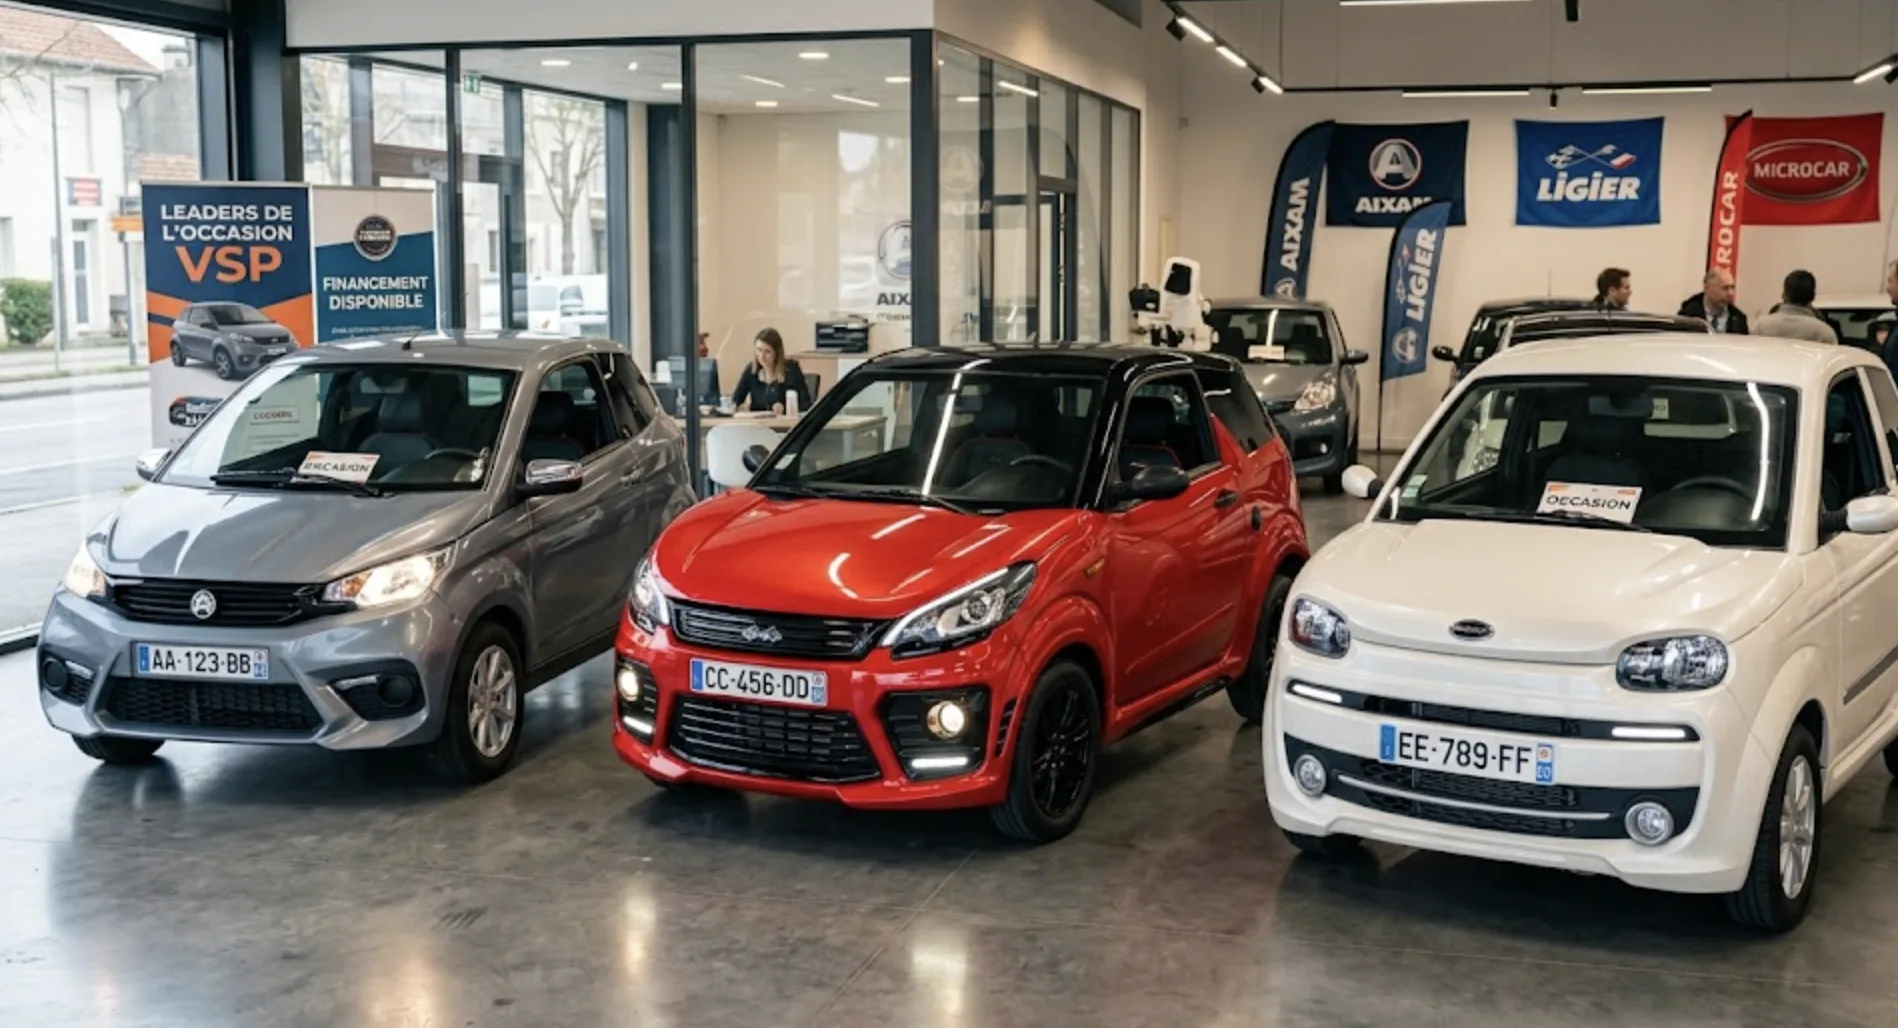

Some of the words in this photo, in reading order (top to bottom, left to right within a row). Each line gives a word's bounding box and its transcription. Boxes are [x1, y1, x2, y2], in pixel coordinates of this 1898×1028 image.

[1754, 161, 1850, 178] MICROCAR
[160, 204, 259, 221] LEADERS
[264, 205, 293, 221] DE
[1280, 177, 1311, 272] AIXAM
[162, 225, 293, 242] L'OCCASION
[175, 245, 283, 283] VSP
[323, 276, 428, 291] FINANCEMENT
[329, 294, 424, 310] DISPONIBLE
[876, 292, 912, 306] AIX
[152, 649, 251, 674] AA-123-BB
[705, 666, 809, 698] CC-456-DD
[1399, 732, 1532, 774] EE-789-FF
